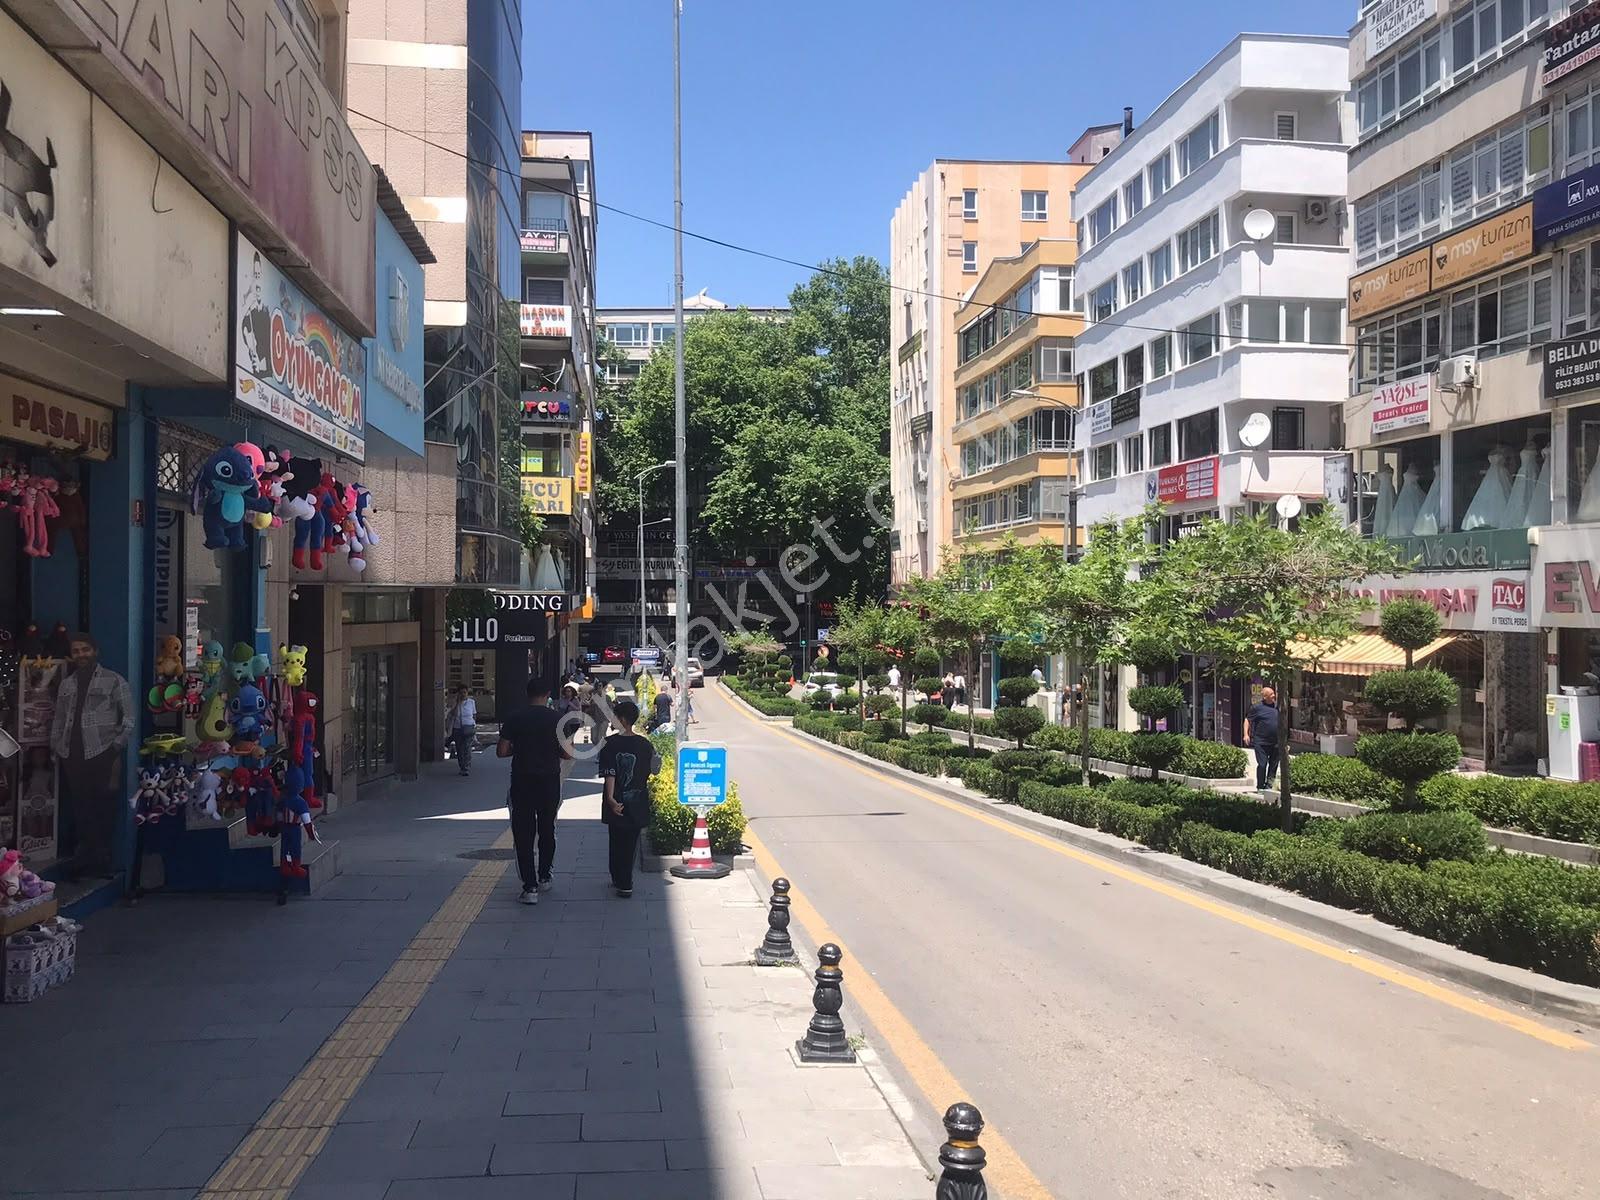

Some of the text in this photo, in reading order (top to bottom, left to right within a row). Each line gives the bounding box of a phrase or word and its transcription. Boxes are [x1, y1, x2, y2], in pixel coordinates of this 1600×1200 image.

[264, 11, 363, 222] KPSS
[1586, 184, 1600, 198] AXA
[1419, 537, 1489, 567] Moda
[1493, 585, 1524, 609] TAÇ
